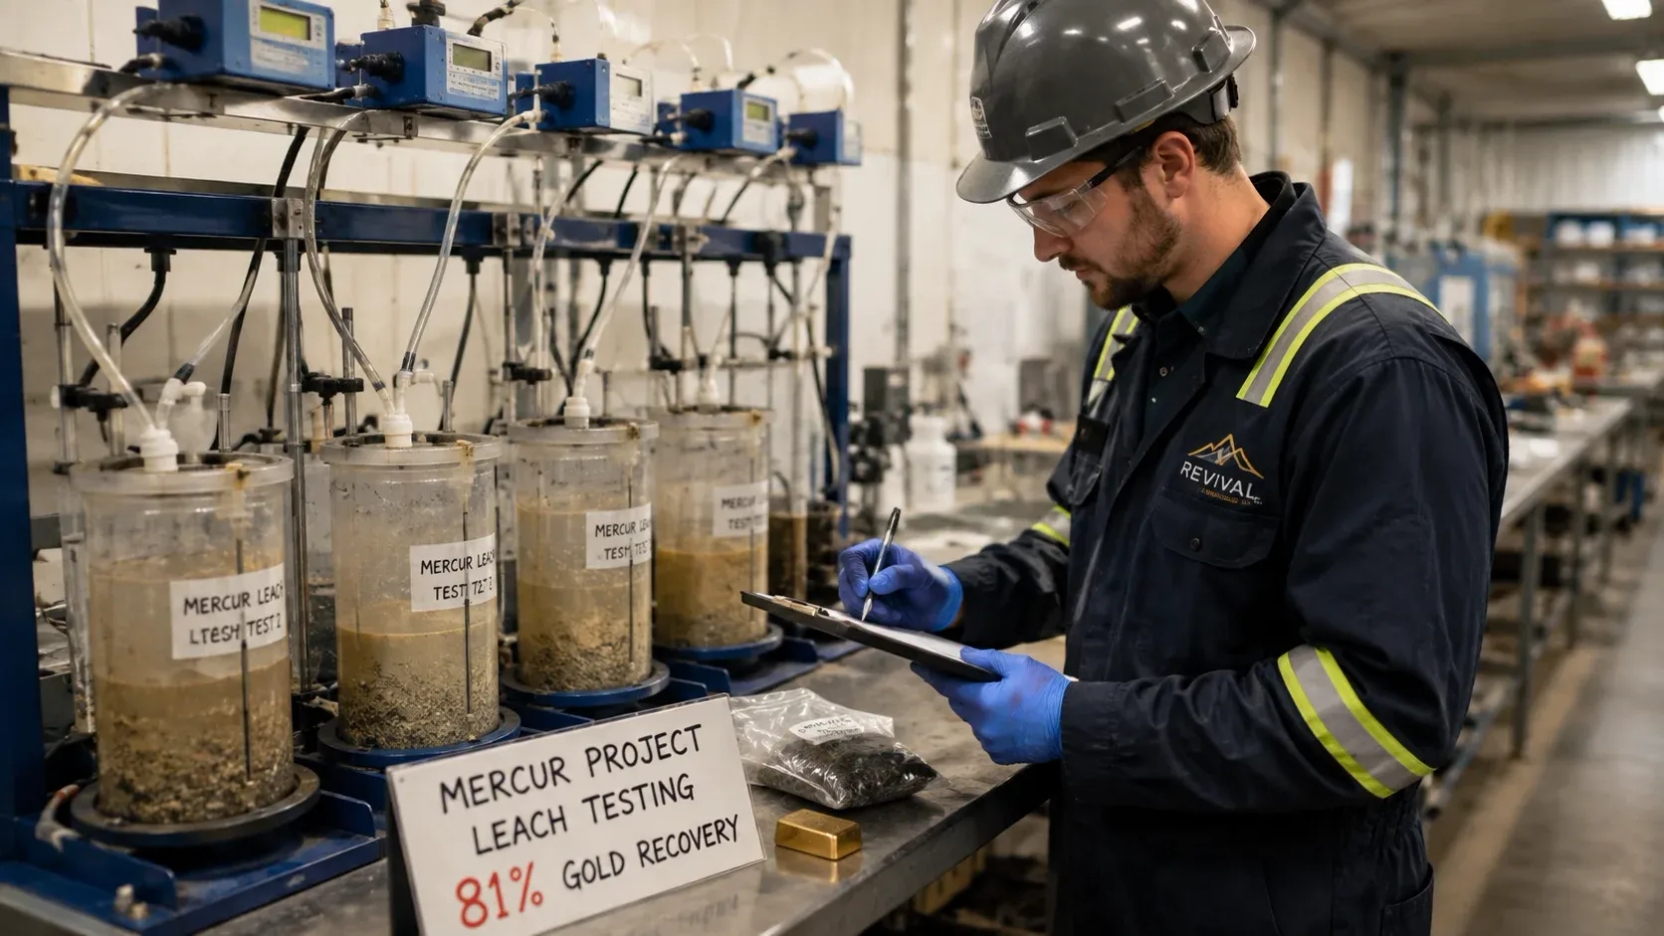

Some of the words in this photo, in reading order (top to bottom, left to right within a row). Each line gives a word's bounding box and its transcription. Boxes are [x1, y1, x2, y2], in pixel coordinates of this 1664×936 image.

[1180, 460, 1254, 499] REVIVAL
[595, 521, 636, 537] MERCUR
[421, 556, 473, 575] MERCUR
[183, 592, 251, 616] MERCUR
[440, 756, 571, 814] MERCUR
[585, 723, 702, 778] PROJECT
[472, 805, 568, 856] LEACH
[581, 772, 695, 824] TESTING
[455, 861, 544, 929] 81%
[562, 851, 625, 890] GOLD
[636, 813, 739, 868] RECOVERY
